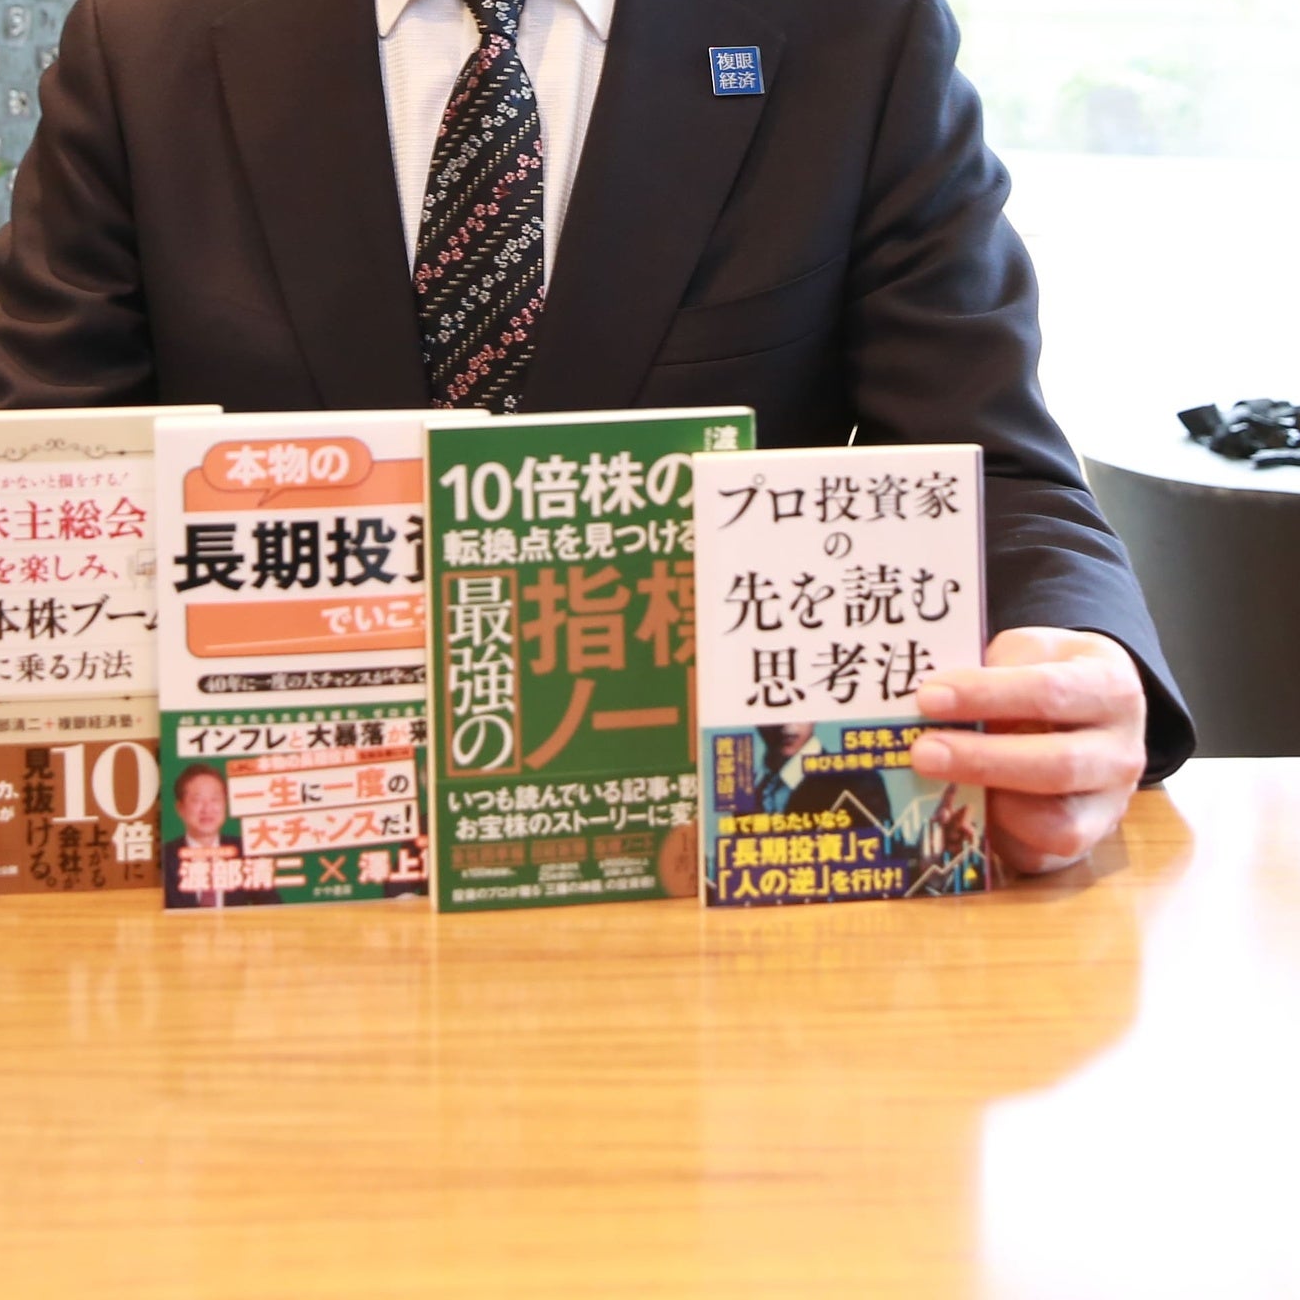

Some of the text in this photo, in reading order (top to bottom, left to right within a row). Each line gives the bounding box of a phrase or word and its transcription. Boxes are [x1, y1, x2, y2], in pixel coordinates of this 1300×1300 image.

[716, 52, 755, 71] 複眼
[719, 71, 757, 90] 経済
[225, 443, 350, 486] 本物の
[439, 451, 694, 522] 10倍株の
[718, 472, 960, 529] プロ投資家
[824, 532, 852, 559] の
[723, 564, 960, 636] 先を読む
[448, 576, 516, 771] 最強の
[746, 640, 936, 708] 思考法
[234, 767, 409, 808] 一生に一度の
[249, 805, 412, 849] 大チャンスだ!
[456, 801, 698, 840] お宝株のストーリーに変
[719, 833, 879, 868] 「長期投資」で
[719, 866, 903, 900] 「人の逆」を行け!
